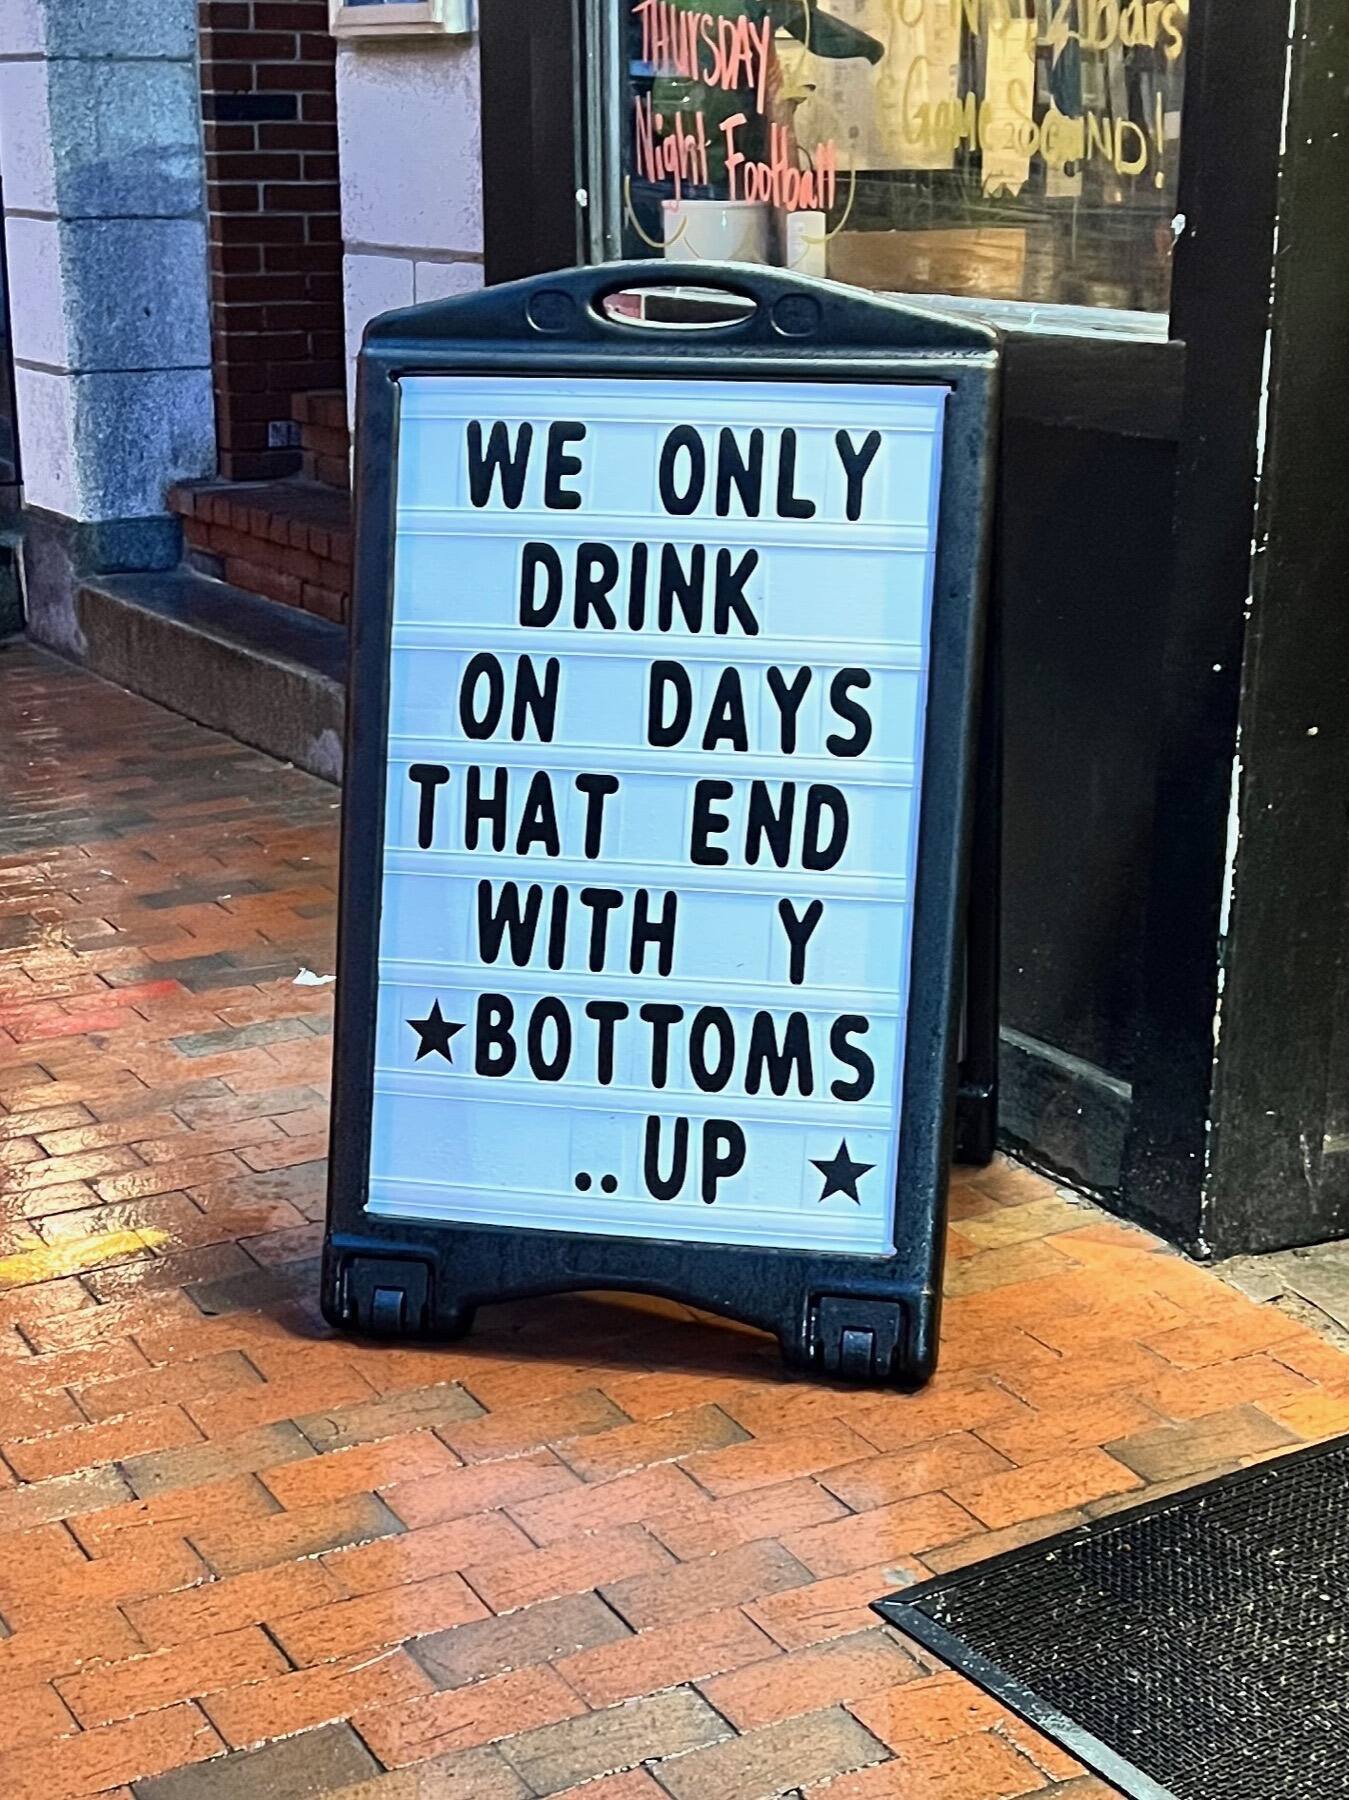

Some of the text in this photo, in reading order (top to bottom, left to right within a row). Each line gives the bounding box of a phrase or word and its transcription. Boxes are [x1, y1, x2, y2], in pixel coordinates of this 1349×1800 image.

[634, 90, 837, 212] Night Football
[467, 421, 881, 521] WE ONLY
[520, 543, 758, 635] DRINK
[460, 653, 871, 757] ON DAYS
[409, 764, 848, 871] THAT END
[478, 880, 823, 984] WITH Y
[476, 994, 874, 1101] BOTTOMS
